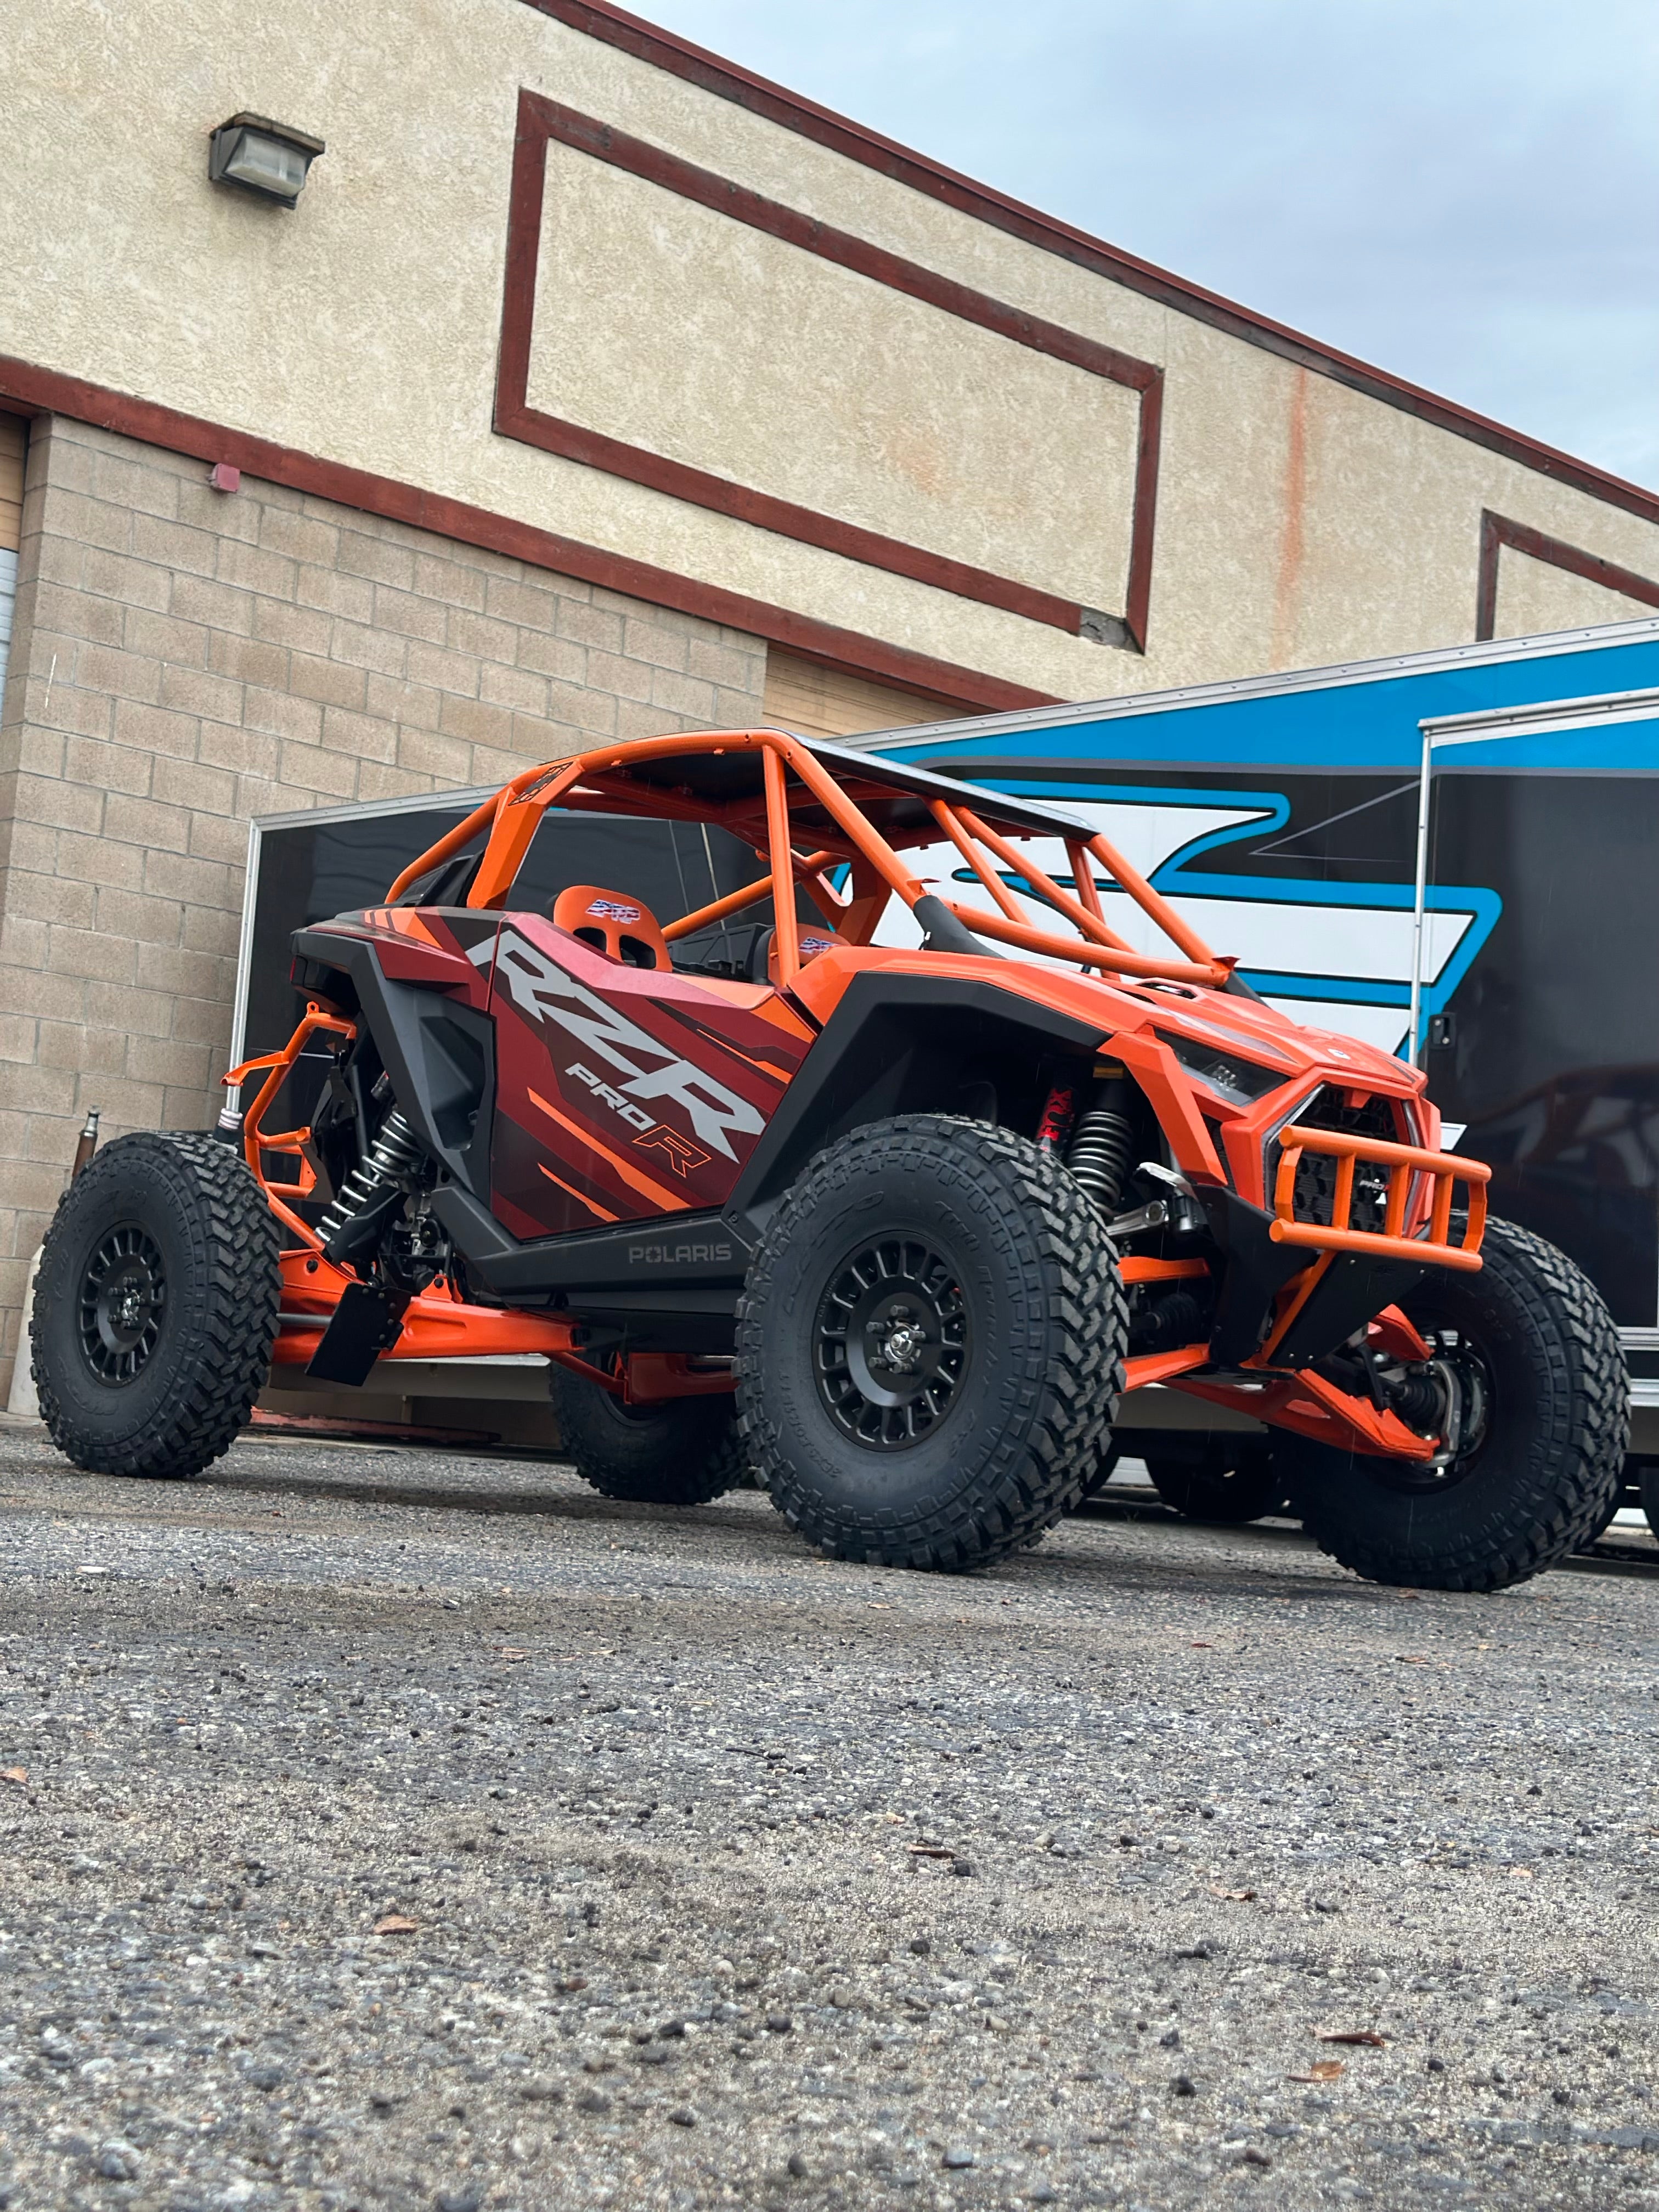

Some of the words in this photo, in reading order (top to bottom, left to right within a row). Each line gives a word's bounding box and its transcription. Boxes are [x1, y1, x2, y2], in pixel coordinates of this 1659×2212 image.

[465, 929, 766, 1164] RZR
[565, 1063, 657, 1131] PRO
[631, 1124, 712, 1178] R
[628, 1243, 732, 1264] POLARIS
